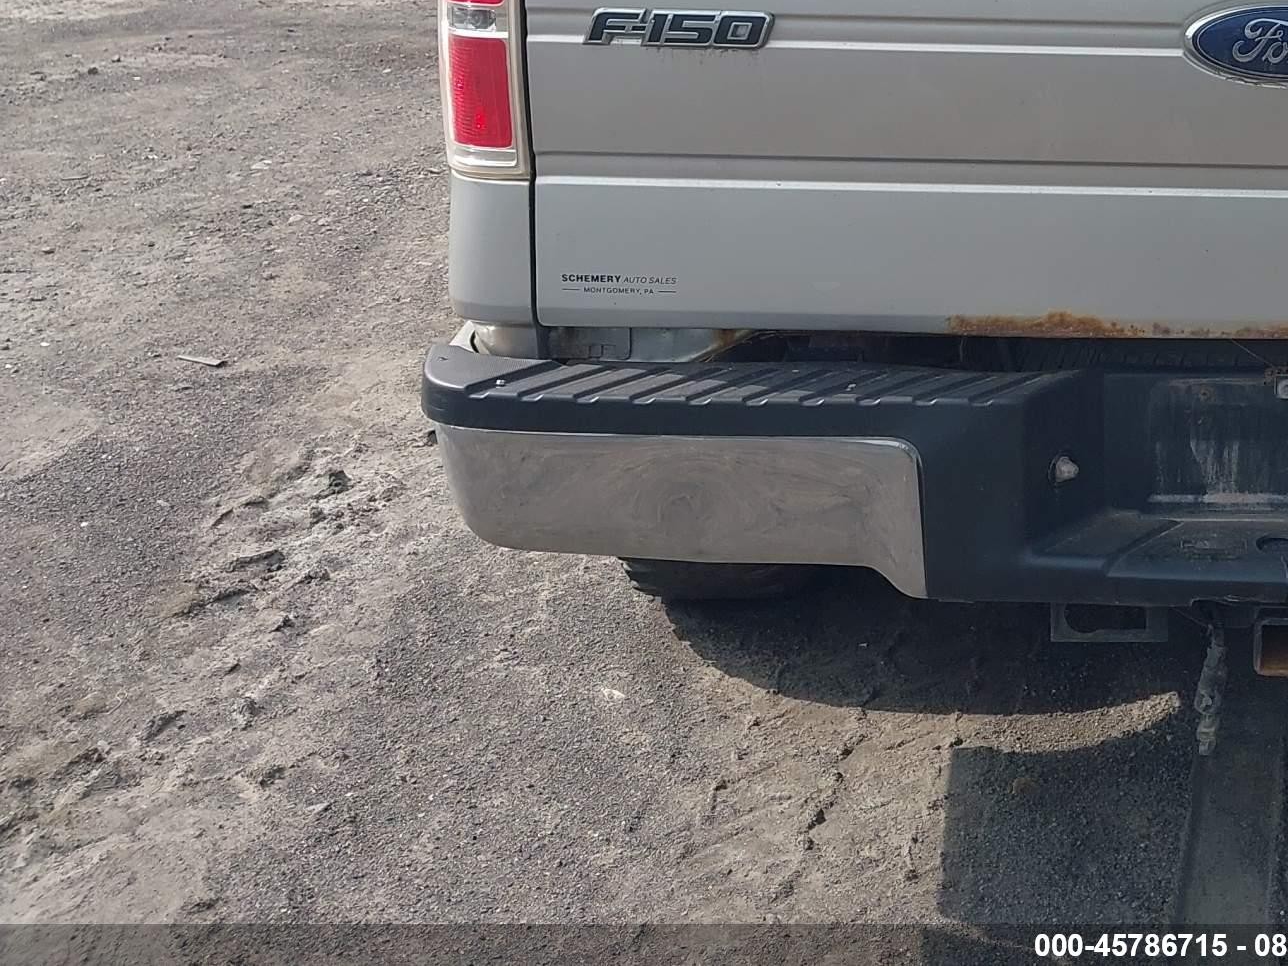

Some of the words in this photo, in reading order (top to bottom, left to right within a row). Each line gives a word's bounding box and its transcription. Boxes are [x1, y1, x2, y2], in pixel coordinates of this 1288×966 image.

[583, 8, 774, 49] F-150
[561, 273, 621, 283] SCHEMERY
[623, 276, 648, 284] AUTO
[648, 276, 677, 285] SALES
